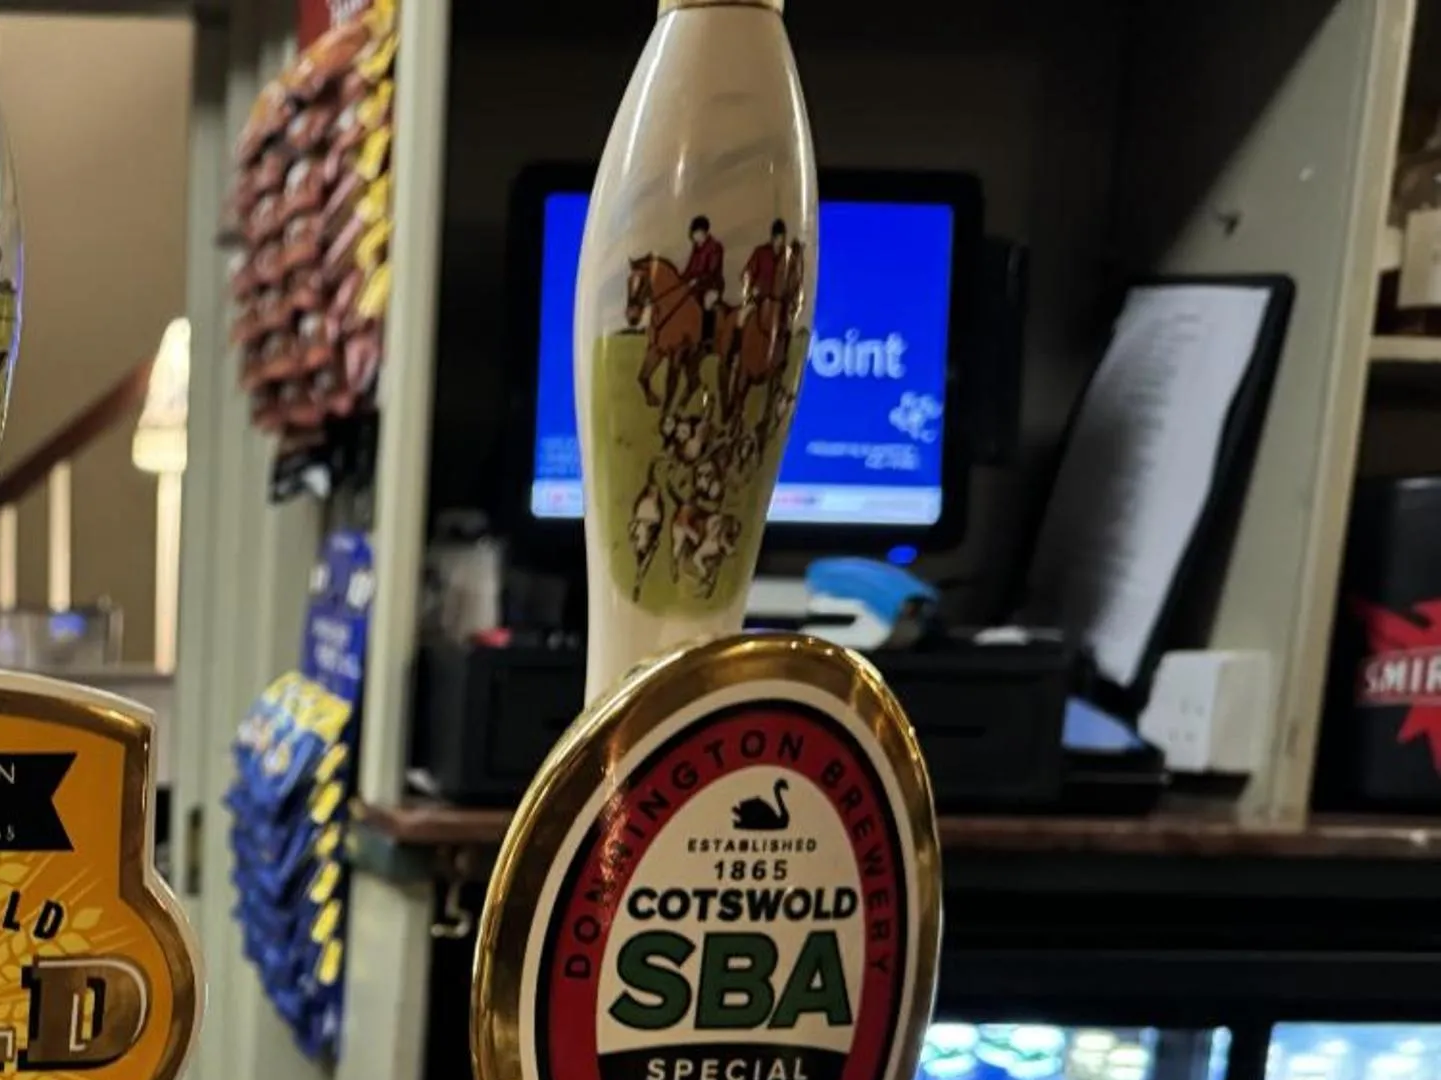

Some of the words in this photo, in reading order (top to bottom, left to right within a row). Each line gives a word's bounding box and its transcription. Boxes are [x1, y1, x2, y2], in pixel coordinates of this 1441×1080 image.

[810, 328, 906, 379] oint
[564, 730, 804, 980] DONNINGTON
[820, 759, 890, 972] BREWERY
[687, 838, 817, 853] ESTABLISHED
[714, 860, 788, 881] 1865
[627, 887, 858, 922] COTSWOLD
[608, 930, 853, 1030] SBA
